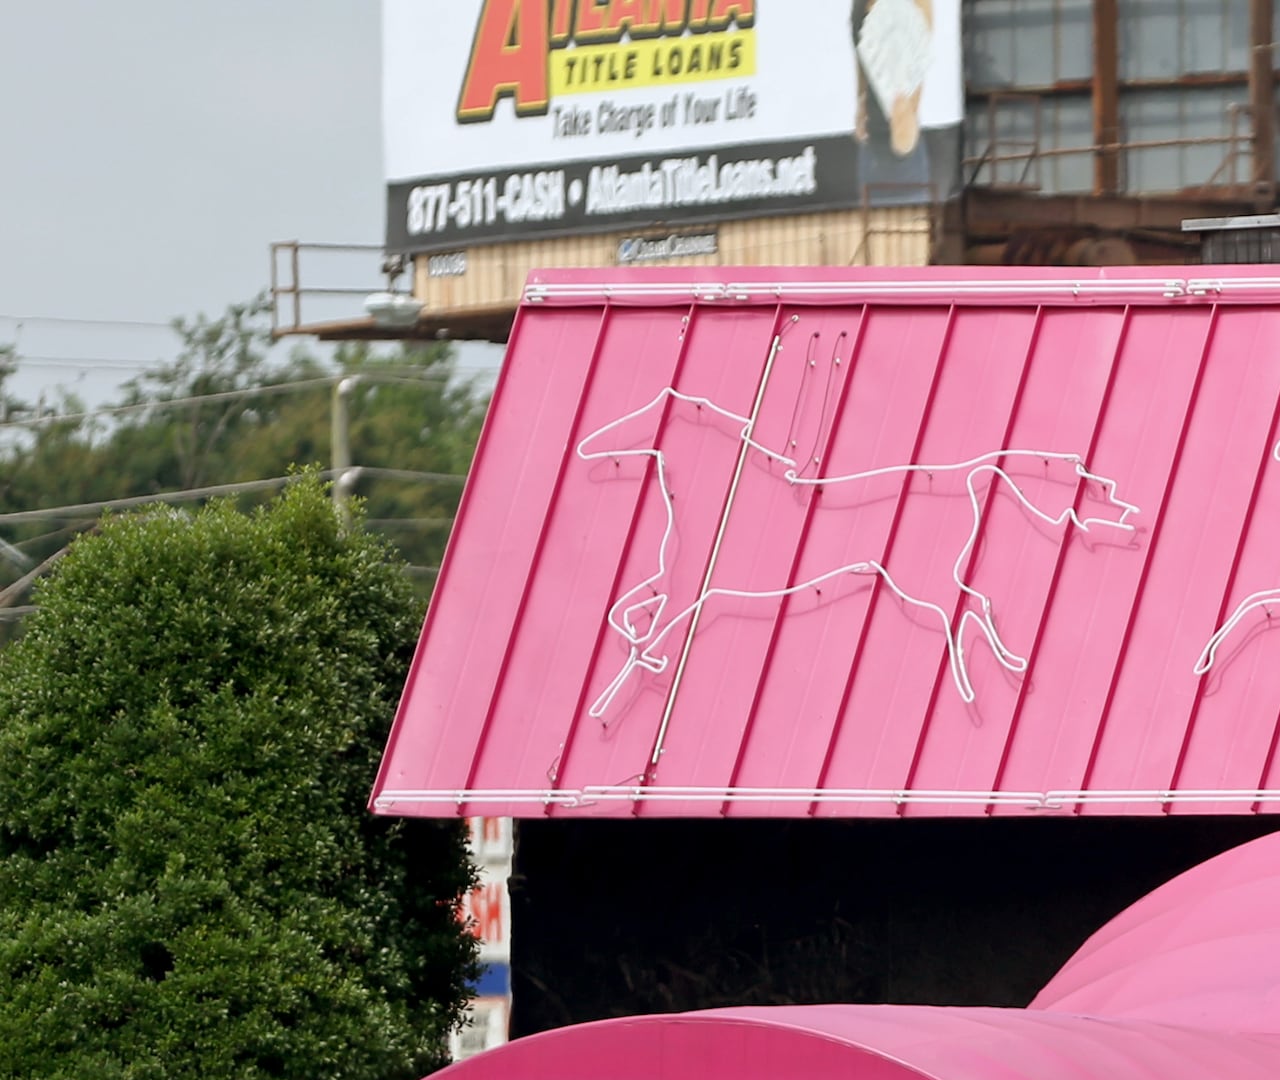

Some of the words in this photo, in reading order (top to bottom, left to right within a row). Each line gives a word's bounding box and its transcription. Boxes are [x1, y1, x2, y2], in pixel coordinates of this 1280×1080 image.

[565, 51, 639, 87] TITLE
[652, 38, 744, 77] LOANS
[553, 104, 593, 139] Take
[596, 100, 655, 139] Charge
[661, 91, 680, 129] of
[682, 90, 723, 126] Your
[725, 85, 758, 121] Life
[407, 169, 566, 236] 877-511-CASH
[585, 145, 818, 216] AtlantaTitleLoans.net
